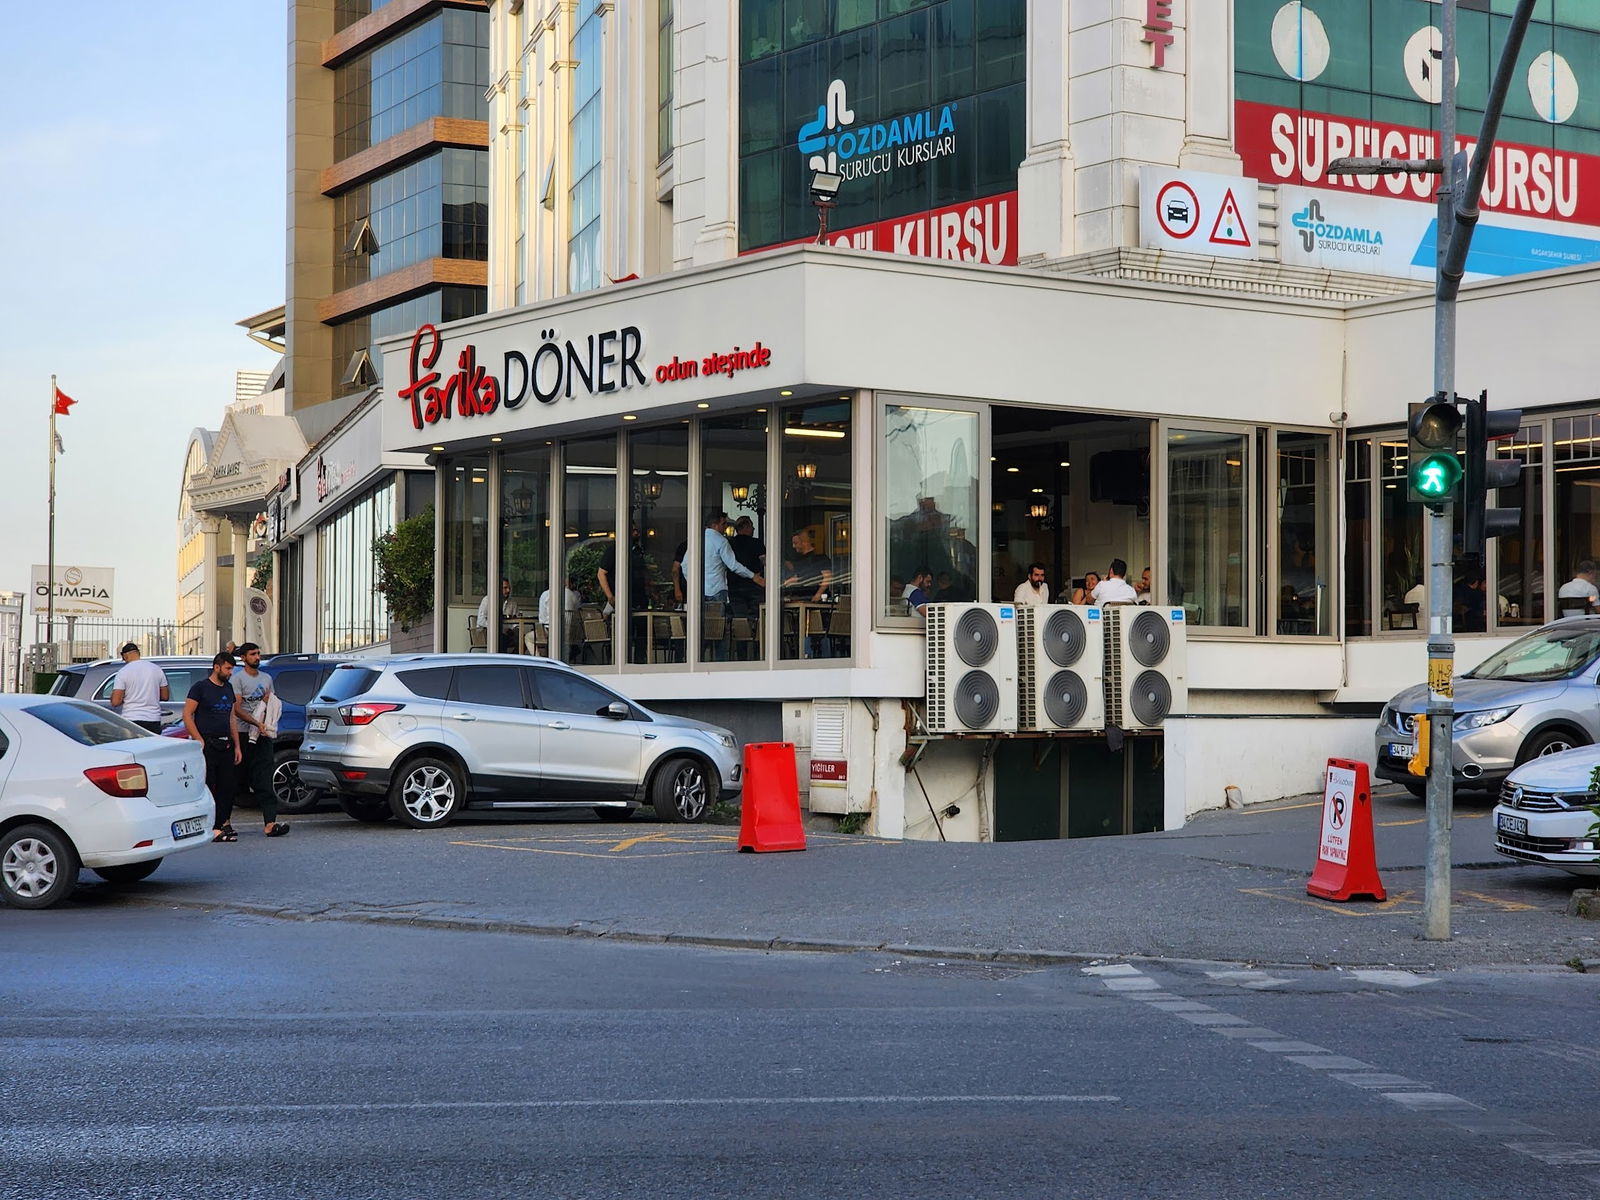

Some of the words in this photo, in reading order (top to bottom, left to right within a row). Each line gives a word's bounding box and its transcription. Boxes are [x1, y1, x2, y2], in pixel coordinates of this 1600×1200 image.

[838, 153, 891, 182] SÜRÜCÜ
[897, 135, 956, 169] KURSLARI
[1270, 112, 1435, 199] SÜRÜCÜ
[504, 326, 648, 410] DÖNER
[655, 357, 699, 383] odun
[701, 342, 771, 378] ateşinde
